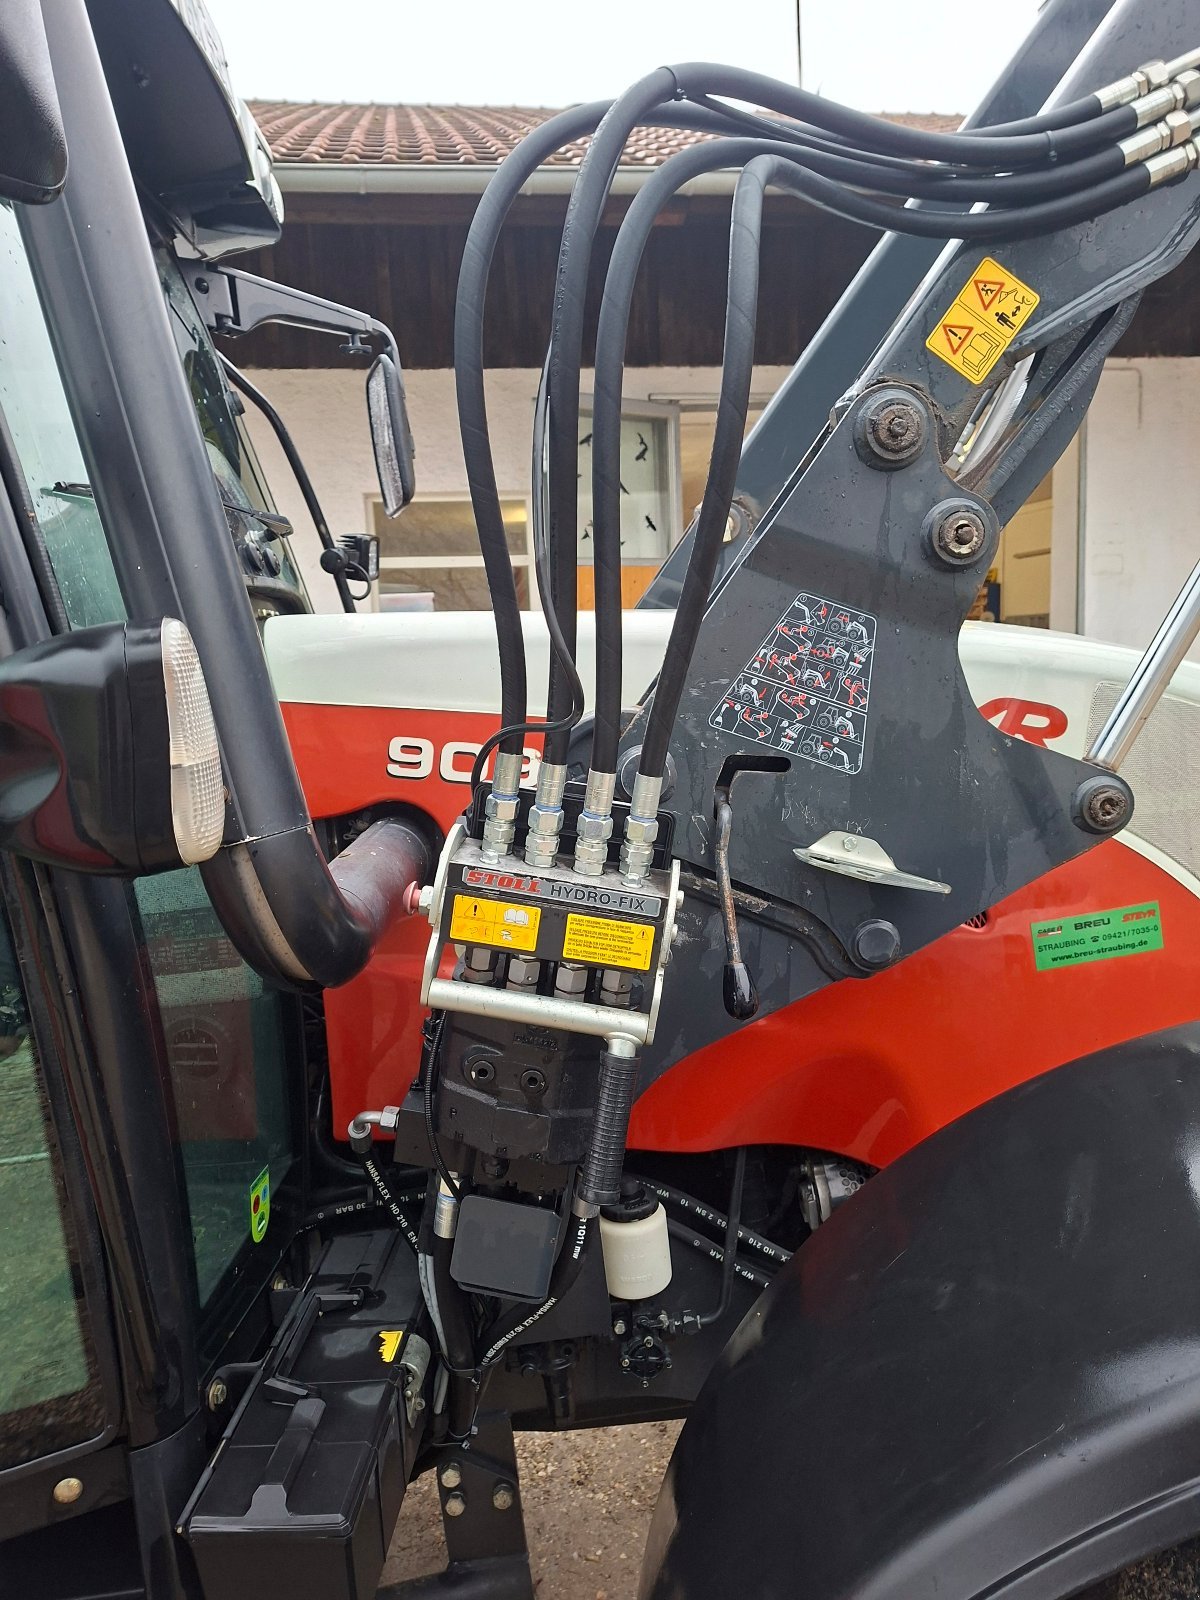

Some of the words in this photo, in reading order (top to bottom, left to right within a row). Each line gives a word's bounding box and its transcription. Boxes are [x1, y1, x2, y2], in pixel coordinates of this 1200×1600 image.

[466, 869, 541, 894] STOLL
[550, 884, 646, 912] HYDRO-FIX
[1121, 909, 1156, 923] STEYR
[1073, 917, 1111, 931] BREU
[1038, 938, 1086, 953] STRAUBING
[1102, 924, 1159, 941] 09421/7035-0
[1051, 939, 1148, 962] www.breu-straubing.de
[656, 1188, 670, 1199] WP
[680, 1198, 689, 1207] 10
[695, 1206, 708, 1217] SN
[389, 1202, 400, 1215] HD
[396, 1214, 408, 1228] 210
[407, 1231, 419, 1244] EN
[716, 1218, 728, 1229] 53
[748, 1237, 762, 1249] 210
[763, 1246, 775, 1256] HD
[741, 1270, 755, 1281] WP
